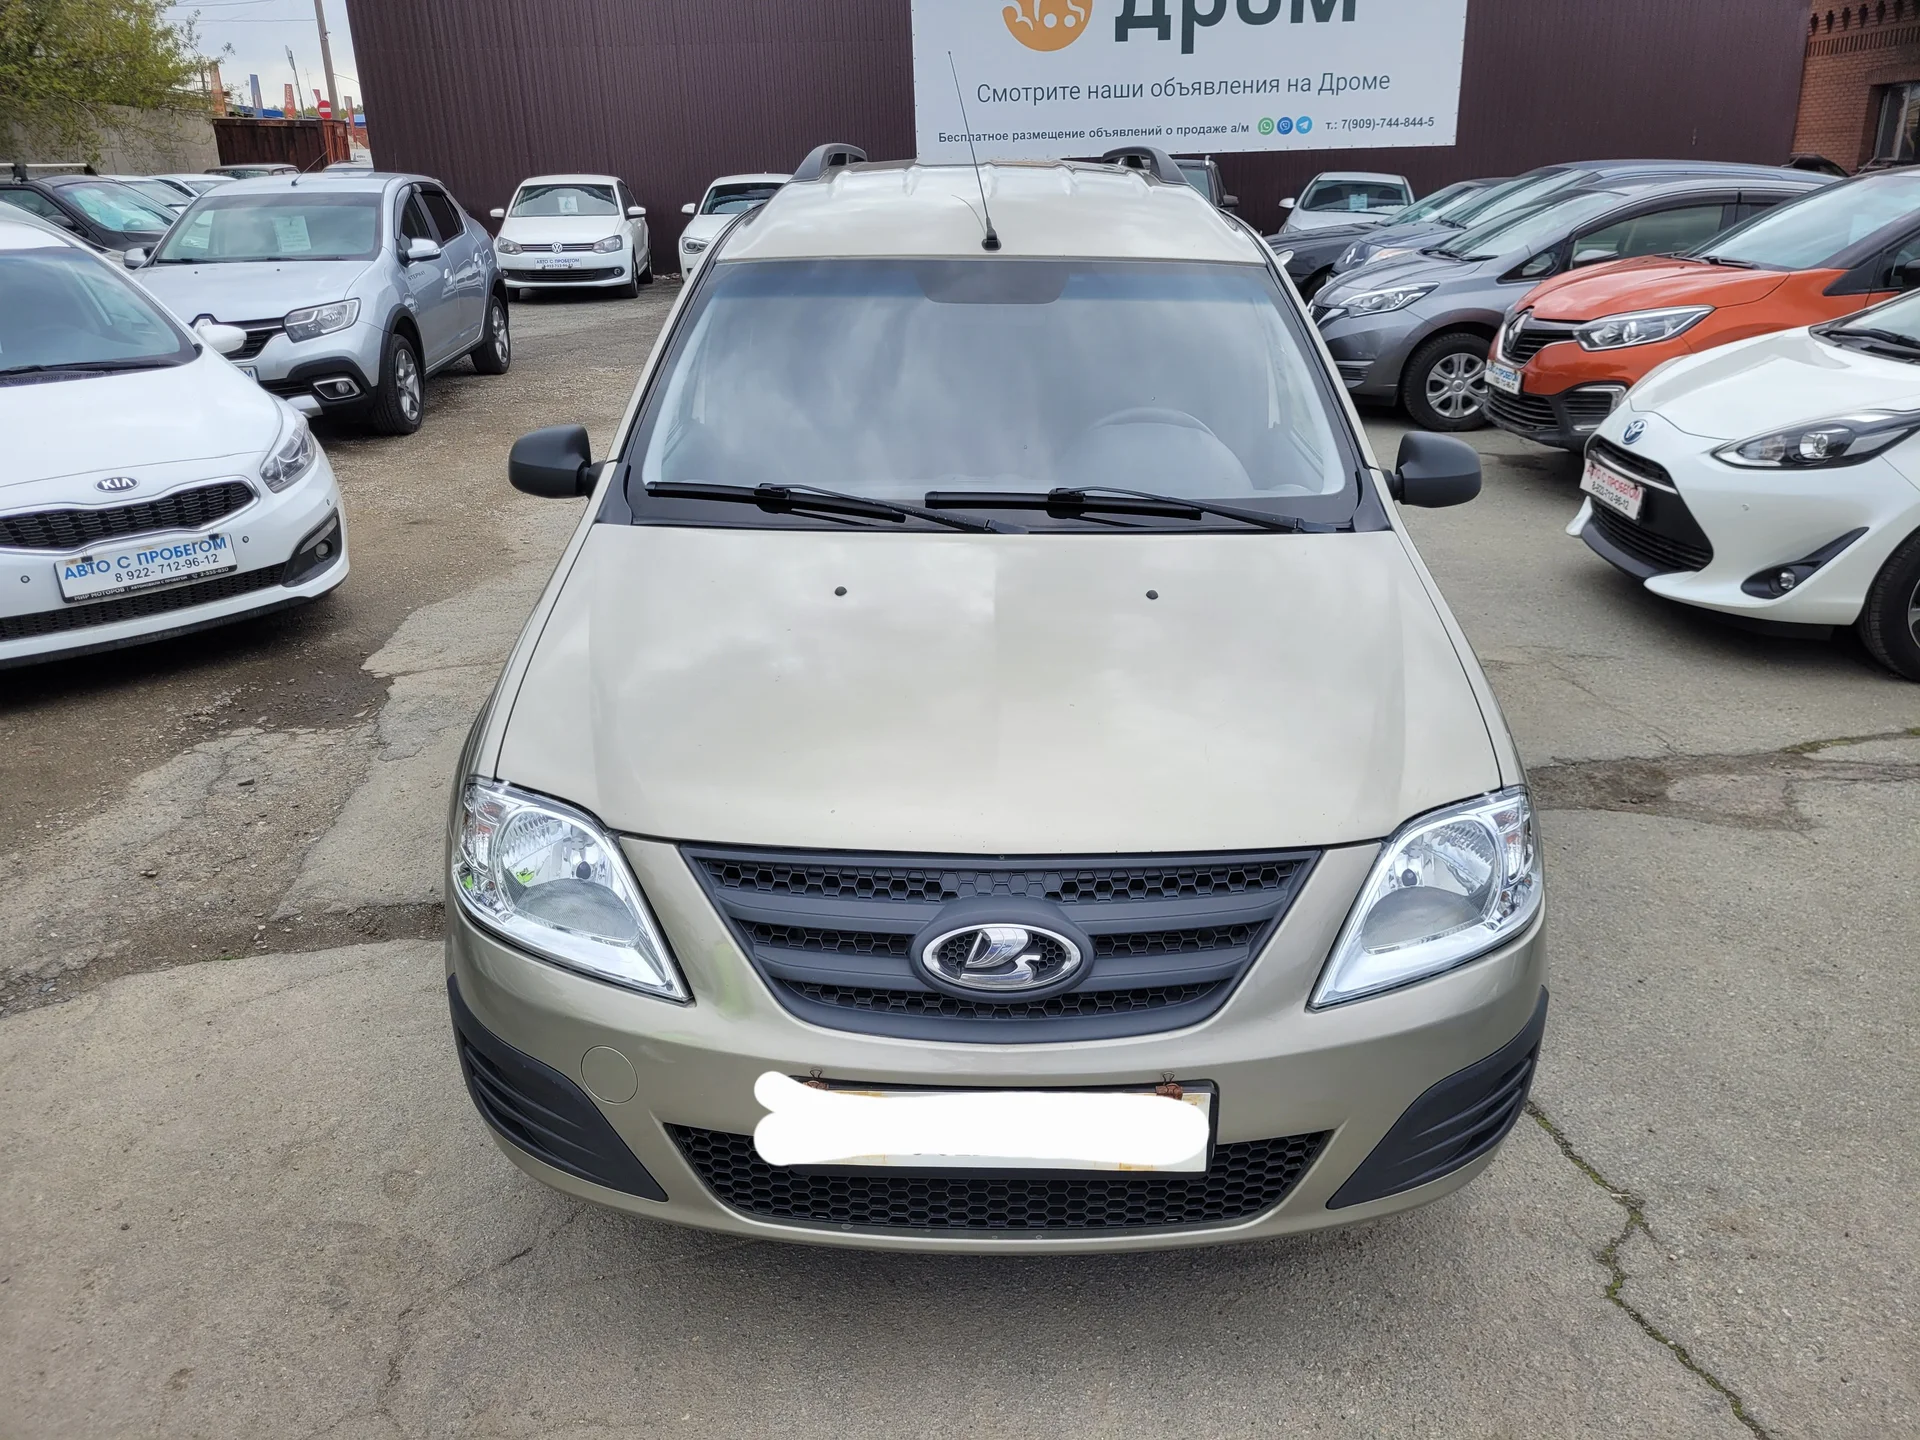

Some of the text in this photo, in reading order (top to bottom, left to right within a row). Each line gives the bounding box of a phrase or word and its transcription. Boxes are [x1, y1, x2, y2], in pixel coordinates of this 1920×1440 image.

[977, 73, 1390, 106] Смотрите наши объявления на Дроме
[938, 122, 1250, 143] Бесплатное размещение объявлений о продаже а/м
[1325, 117, 1435, 131] т.: 7(909)-744-844-5
[101, 477, 134, 490] KIA
[64, 536, 227, 580] АВТО С ПРОБЕГОМ
[114, 572, 123, 583] 8
[158, 553, 219, 574] 712-96-12
[91, 587, 125, 598] МОТОРОВ
